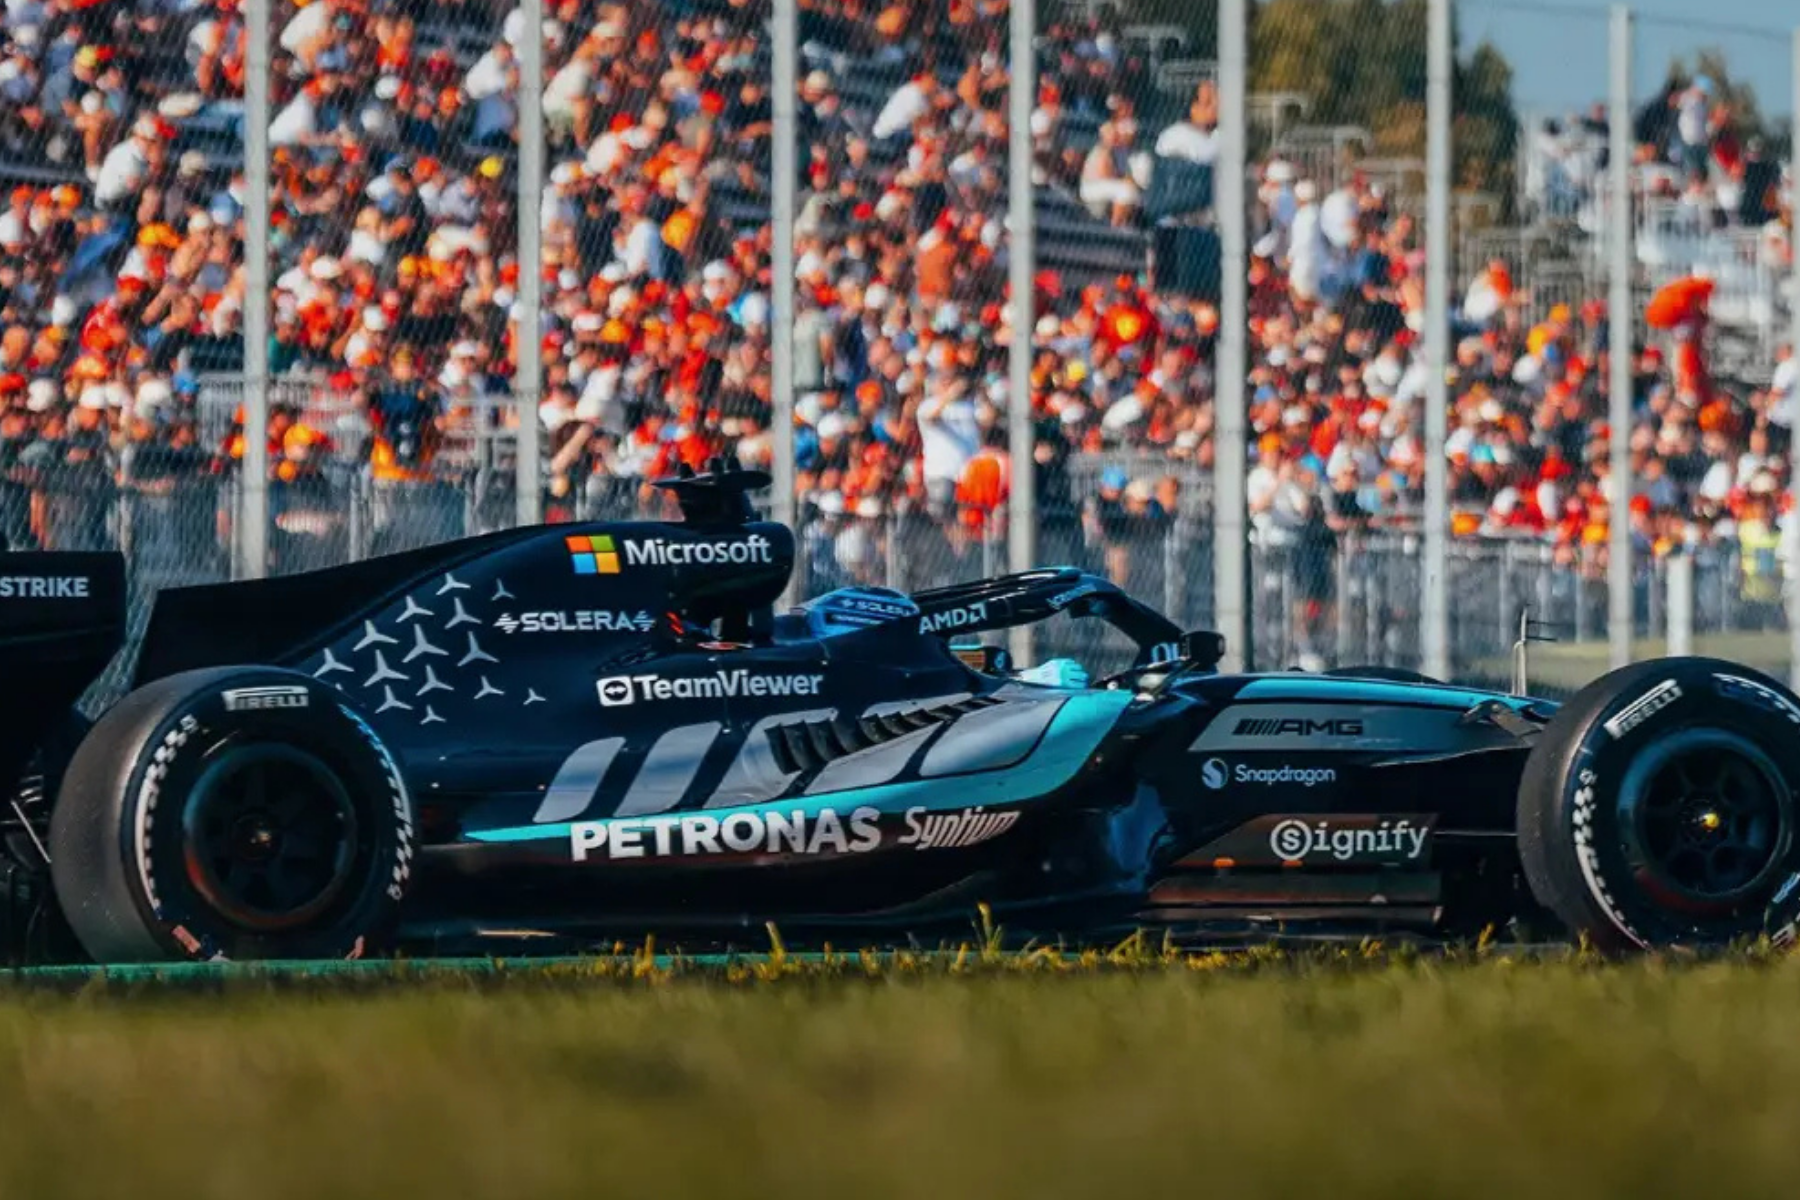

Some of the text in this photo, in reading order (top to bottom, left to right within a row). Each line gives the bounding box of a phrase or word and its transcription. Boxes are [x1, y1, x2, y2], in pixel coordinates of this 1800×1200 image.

[624, 535, 771, 566] Microsoft
[0, 577, 88, 597] STRIKE
[521, 612, 634, 632] SOLERA
[919, 608, 967, 635] AMD
[222, 686, 309, 711] PIRELLI
[635, 671, 823, 700] TeamViewer
[1604, 679, 1683, 739] PIRELLI
[1280, 719, 1362, 736] AMG
[1235, 765, 1336, 786] Snapdragon
[570, 806, 1020, 863] PETRONAS Syntium
